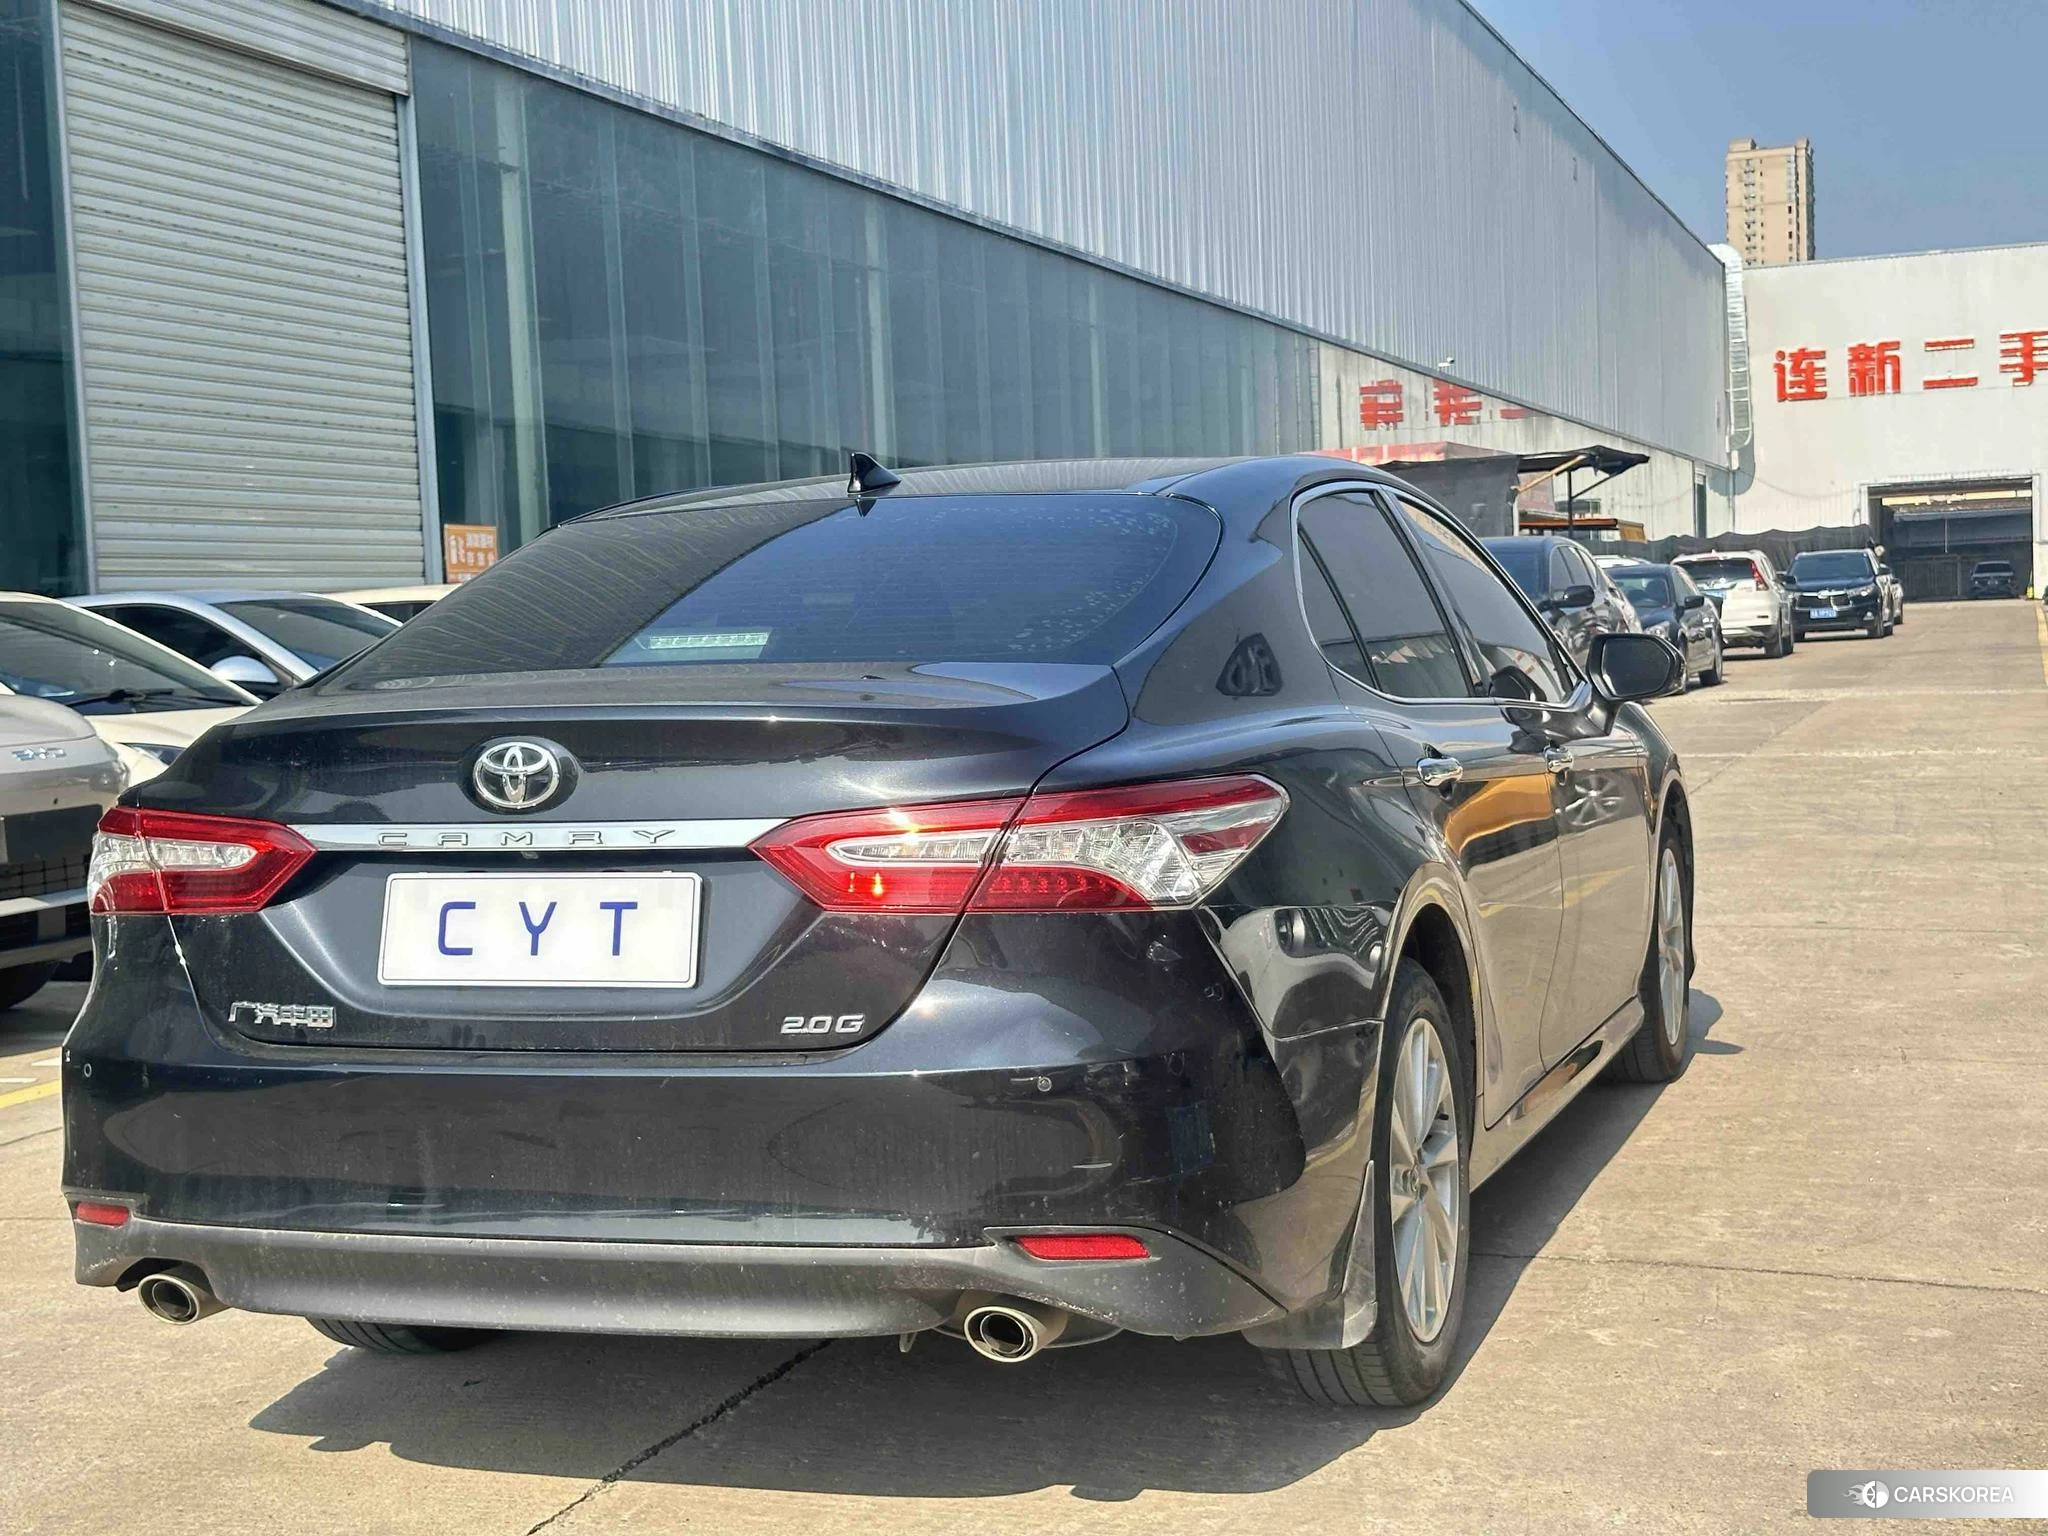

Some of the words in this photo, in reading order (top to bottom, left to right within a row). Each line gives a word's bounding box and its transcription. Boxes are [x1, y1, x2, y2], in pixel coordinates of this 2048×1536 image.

[1773, 330, 2048, 402] 连新二手
[377, 829, 676, 847] CAMRY
[228, 1001, 335, 1029] 广汽丰田
[780, 1014, 865, 1034] 2.0G
